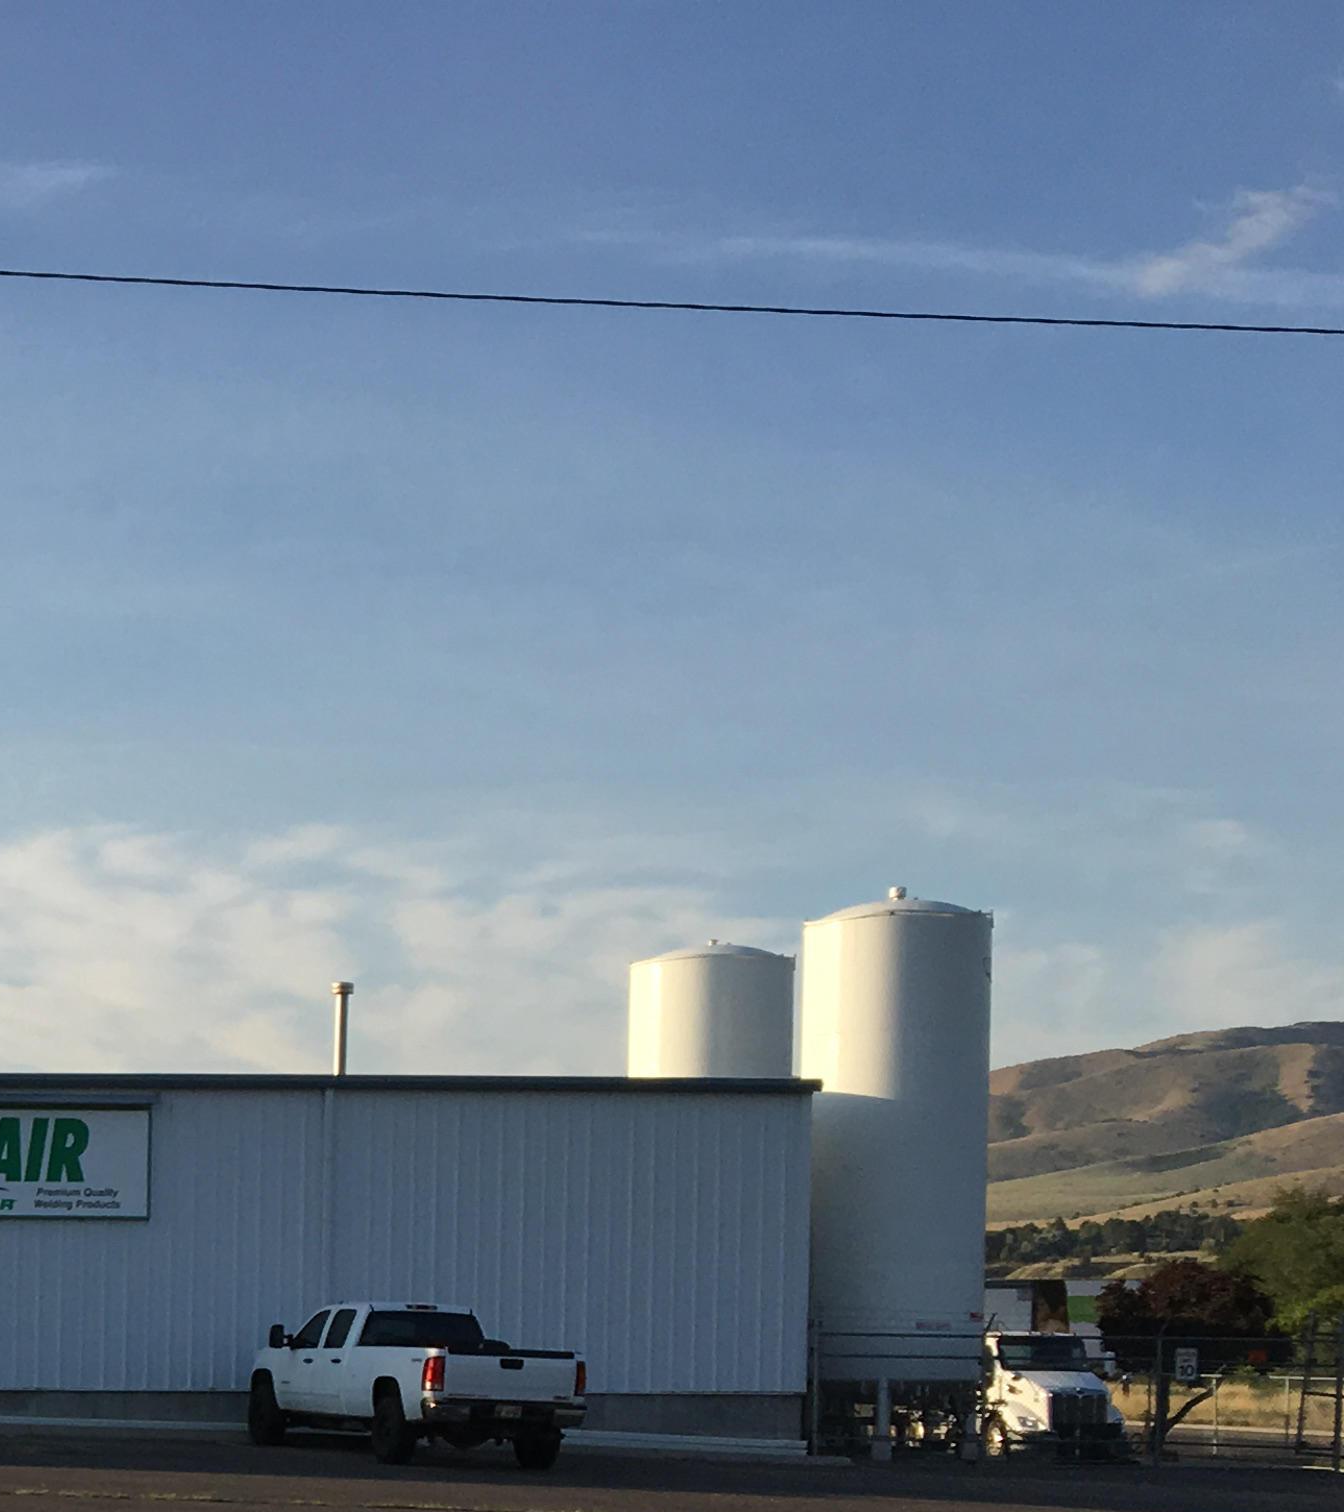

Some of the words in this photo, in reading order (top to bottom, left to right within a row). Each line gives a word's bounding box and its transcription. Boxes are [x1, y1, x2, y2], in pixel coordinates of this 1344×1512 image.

[36, 1188, 81, 1198] Premium
[83, 1189, 119, 1199] Quality
[34, 1200, 73, 1211] Welding
[75, 1200, 121, 1211] Products
[1178, 1364, 1194, 1376] 10
